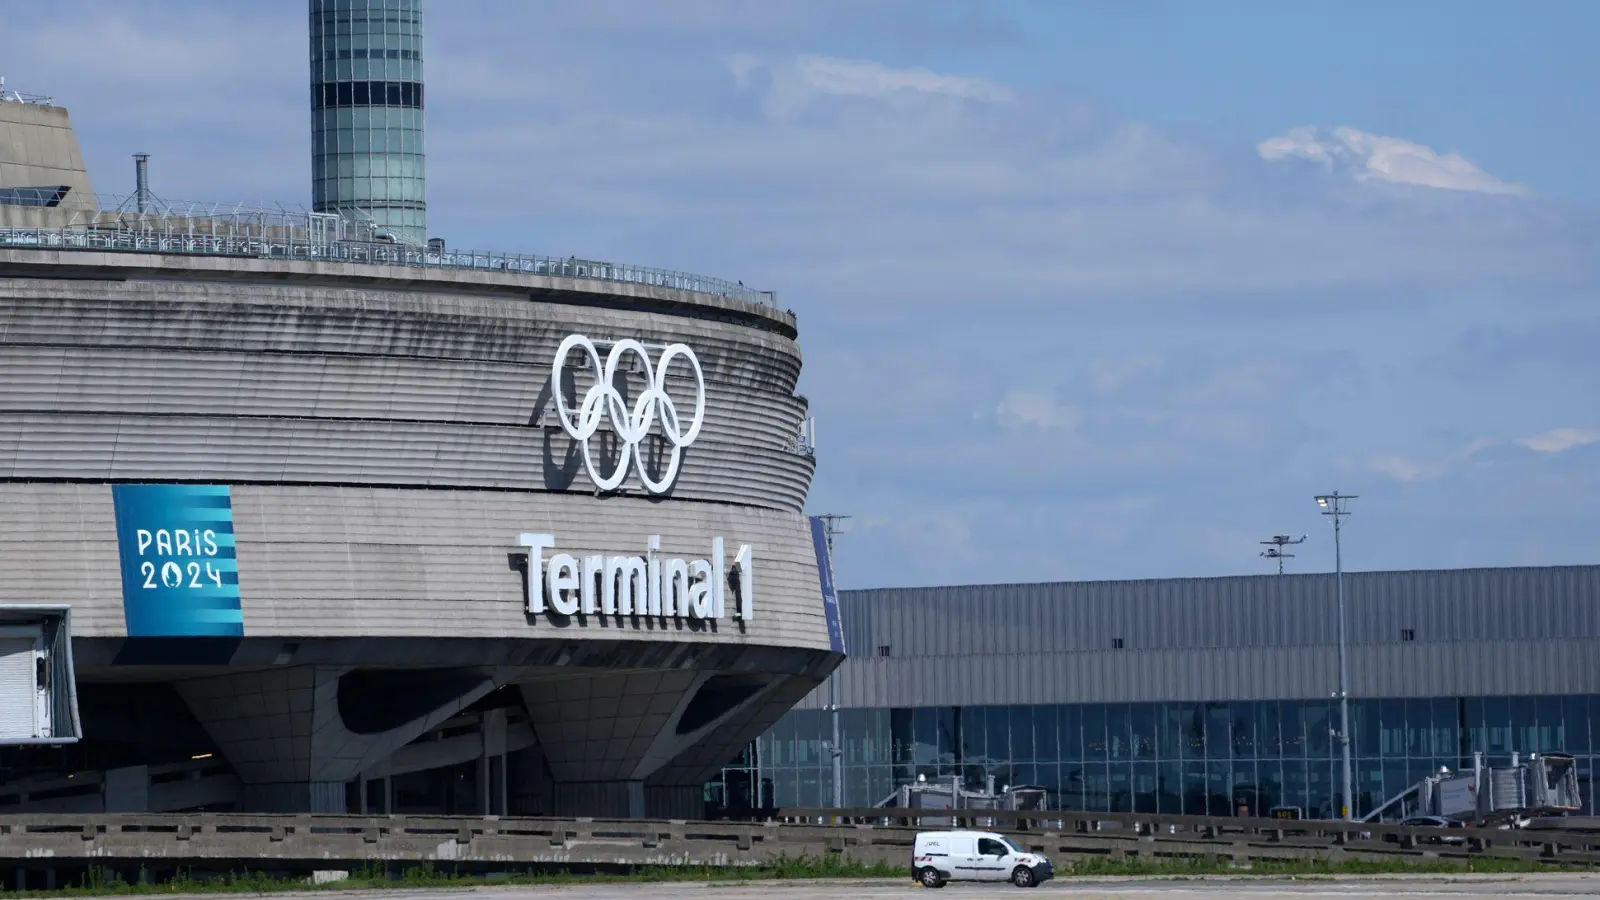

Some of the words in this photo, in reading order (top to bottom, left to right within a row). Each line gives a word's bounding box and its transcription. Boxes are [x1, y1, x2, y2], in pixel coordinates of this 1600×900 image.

[141, 561, 222, 588] 2024
[516, 532, 725, 619] Terminal
[734, 544, 754, 620] 1
